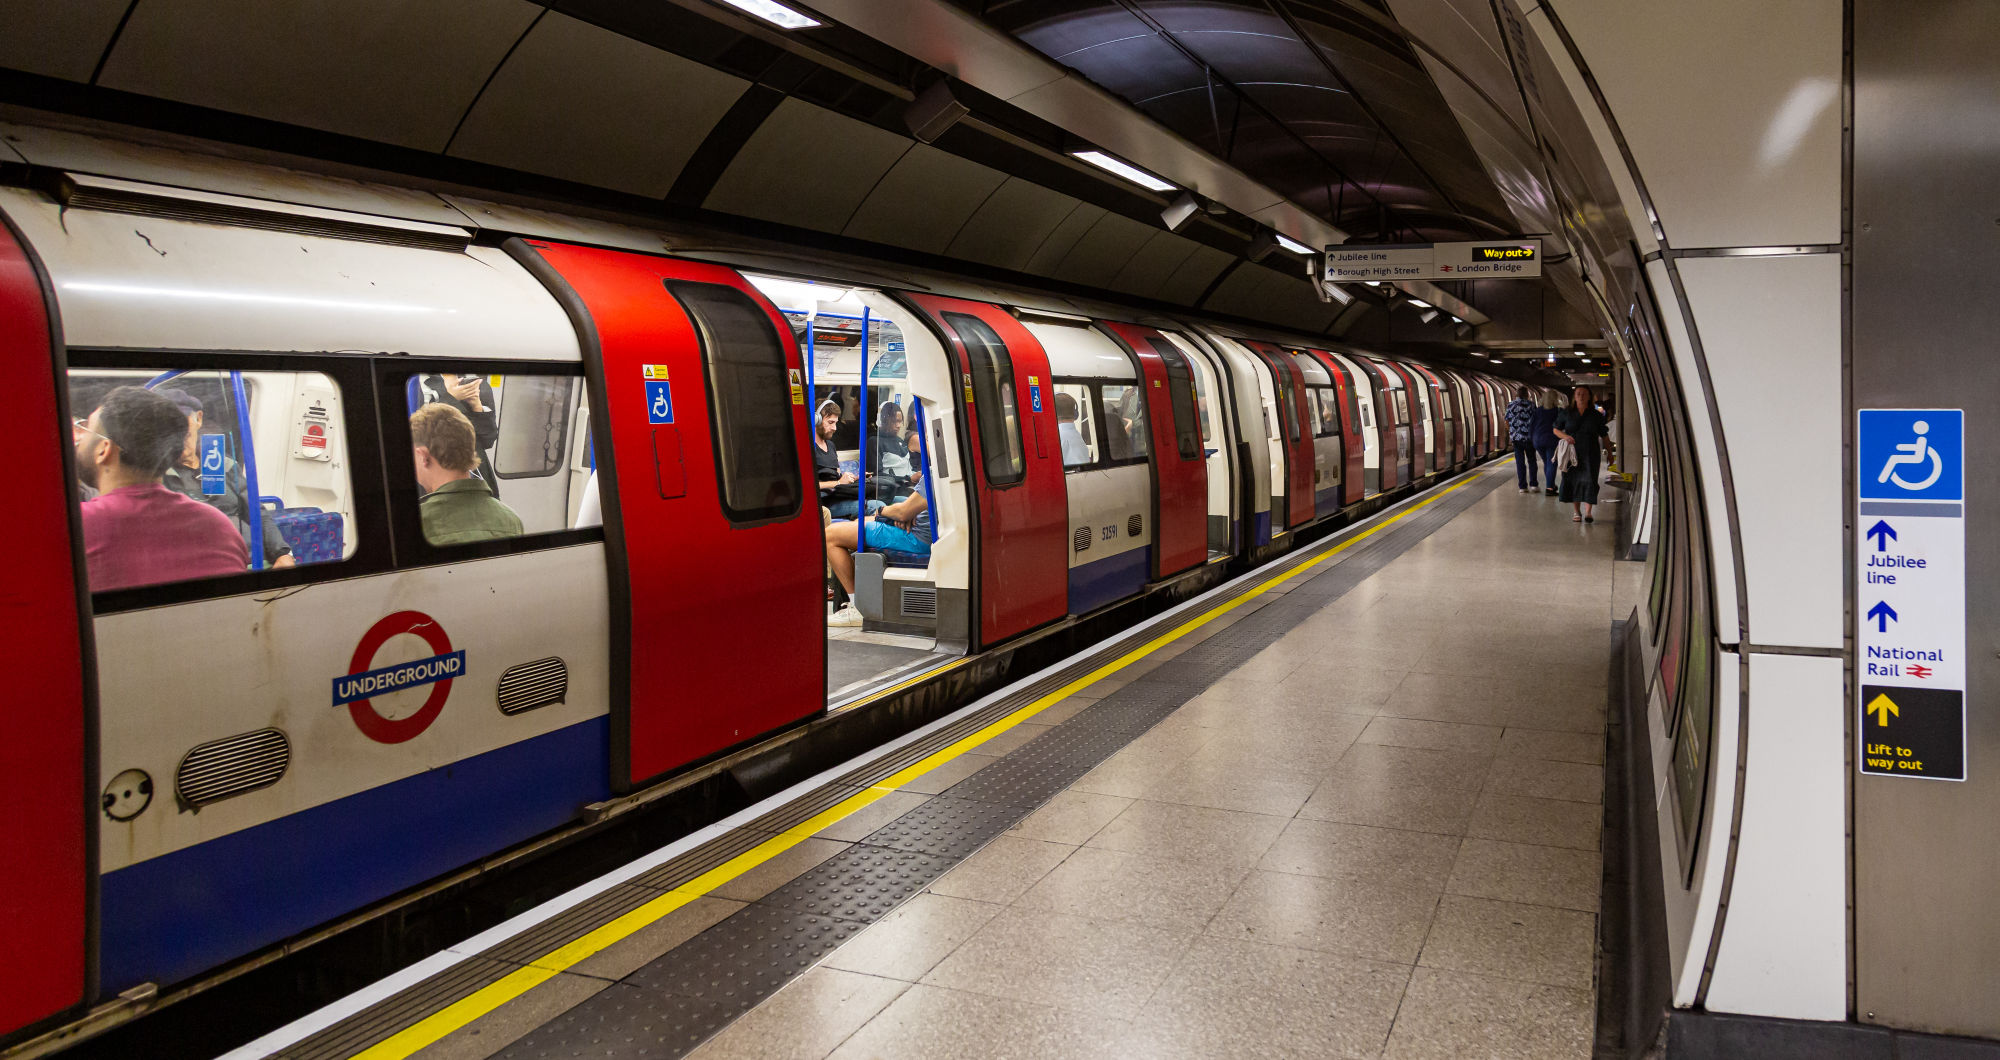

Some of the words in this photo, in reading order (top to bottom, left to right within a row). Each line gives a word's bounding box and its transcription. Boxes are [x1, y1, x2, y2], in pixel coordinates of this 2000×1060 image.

[1337, 253, 1369, 261] Jubilee
[1484, 249, 1504, 259] Way
[1506, 249, 1522, 257] out
[1337, 268, 1371, 277] Borough
[1373, 267, 1391, 276] High
[1394, 267, 1420, 275] Street
[1456, 264, 1490, 273] London
[1493, 263, 1522, 273] Bridge
[1102, 524, 1118, 541] 52591
[1867, 555, 1926, 568] Jubilee
[1867, 571, 1897, 584] line
[1867, 646, 1944, 662] National
[1867, 663, 1900, 677] Rail
[339, 657, 461, 698] UNDERGROUND
[1867, 743, 1892, 756] Lift
[1896, 746, 1912, 757] to
[1867, 758, 1894, 770] way
[1898, 760, 1923, 771] out
